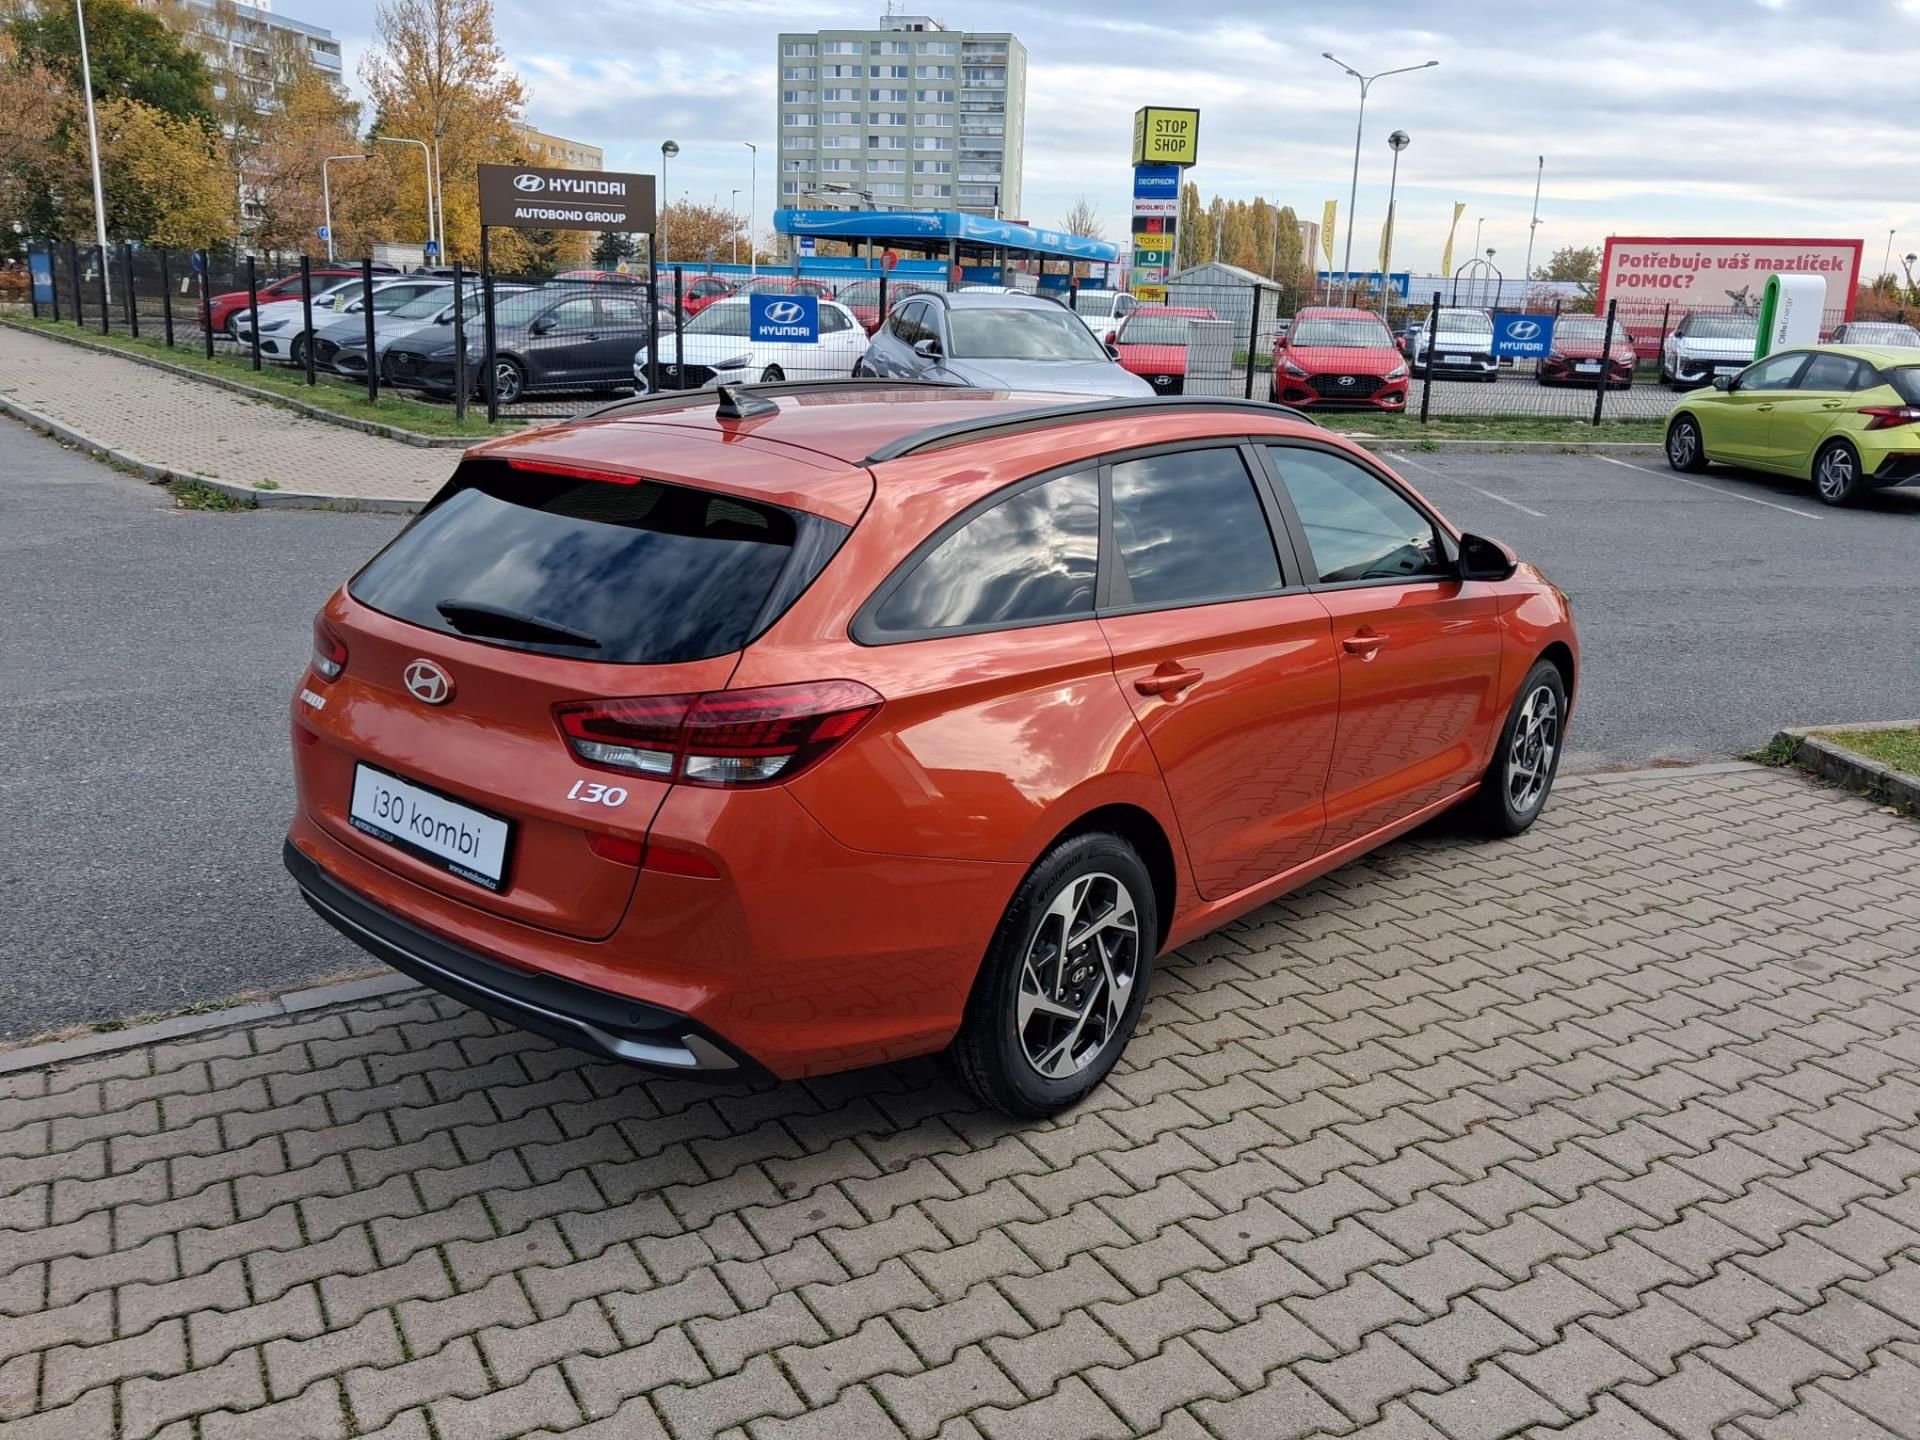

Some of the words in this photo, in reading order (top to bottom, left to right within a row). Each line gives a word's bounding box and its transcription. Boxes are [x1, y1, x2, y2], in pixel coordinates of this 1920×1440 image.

[1155, 119, 1188, 134] STOP
[1154, 138, 1186, 152] SHOP
[549, 178, 626, 196] HYUNDAI
[514, 207, 583, 221] AUTOBOND
[584, 211, 626, 223] GROUP
[1618, 252, 1712, 272] Potřebuje
[1717, 253, 1750, 270] váš
[1754, 254, 1844, 272] mazlíček
[1615, 273, 1694, 289] POMOC?
[759, 326, 810, 337] HYUNDAI
[1499, 341, 1544, 352] HYUNDAI
[372, 785, 404, 824] i30
[409, 802, 481, 858] kombi
